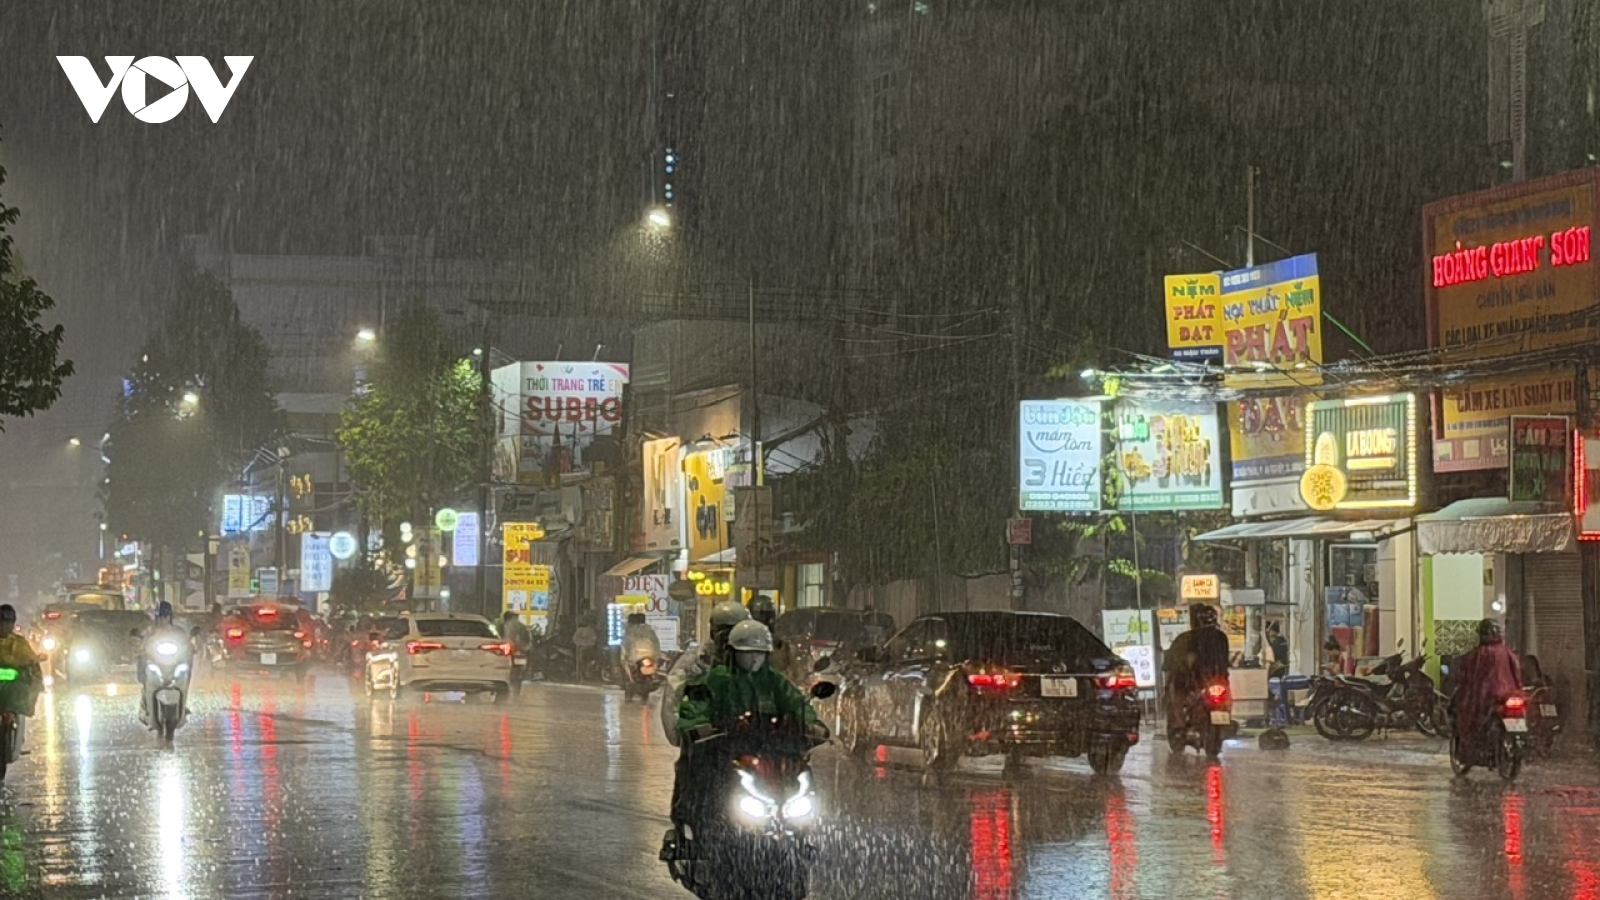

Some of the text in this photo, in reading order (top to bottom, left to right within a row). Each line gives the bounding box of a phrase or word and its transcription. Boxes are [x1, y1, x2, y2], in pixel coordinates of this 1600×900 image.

[1551, 226, 1590, 265] SƠN
[1173, 299, 1216, 321] PHÁT
[1179, 325, 1214, 343] ĐẠT
[1224, 310, 1315, 364] PHÁT
[551, 378, 584, 391] TRANG
[1024, 458, 1046, 486] 3
